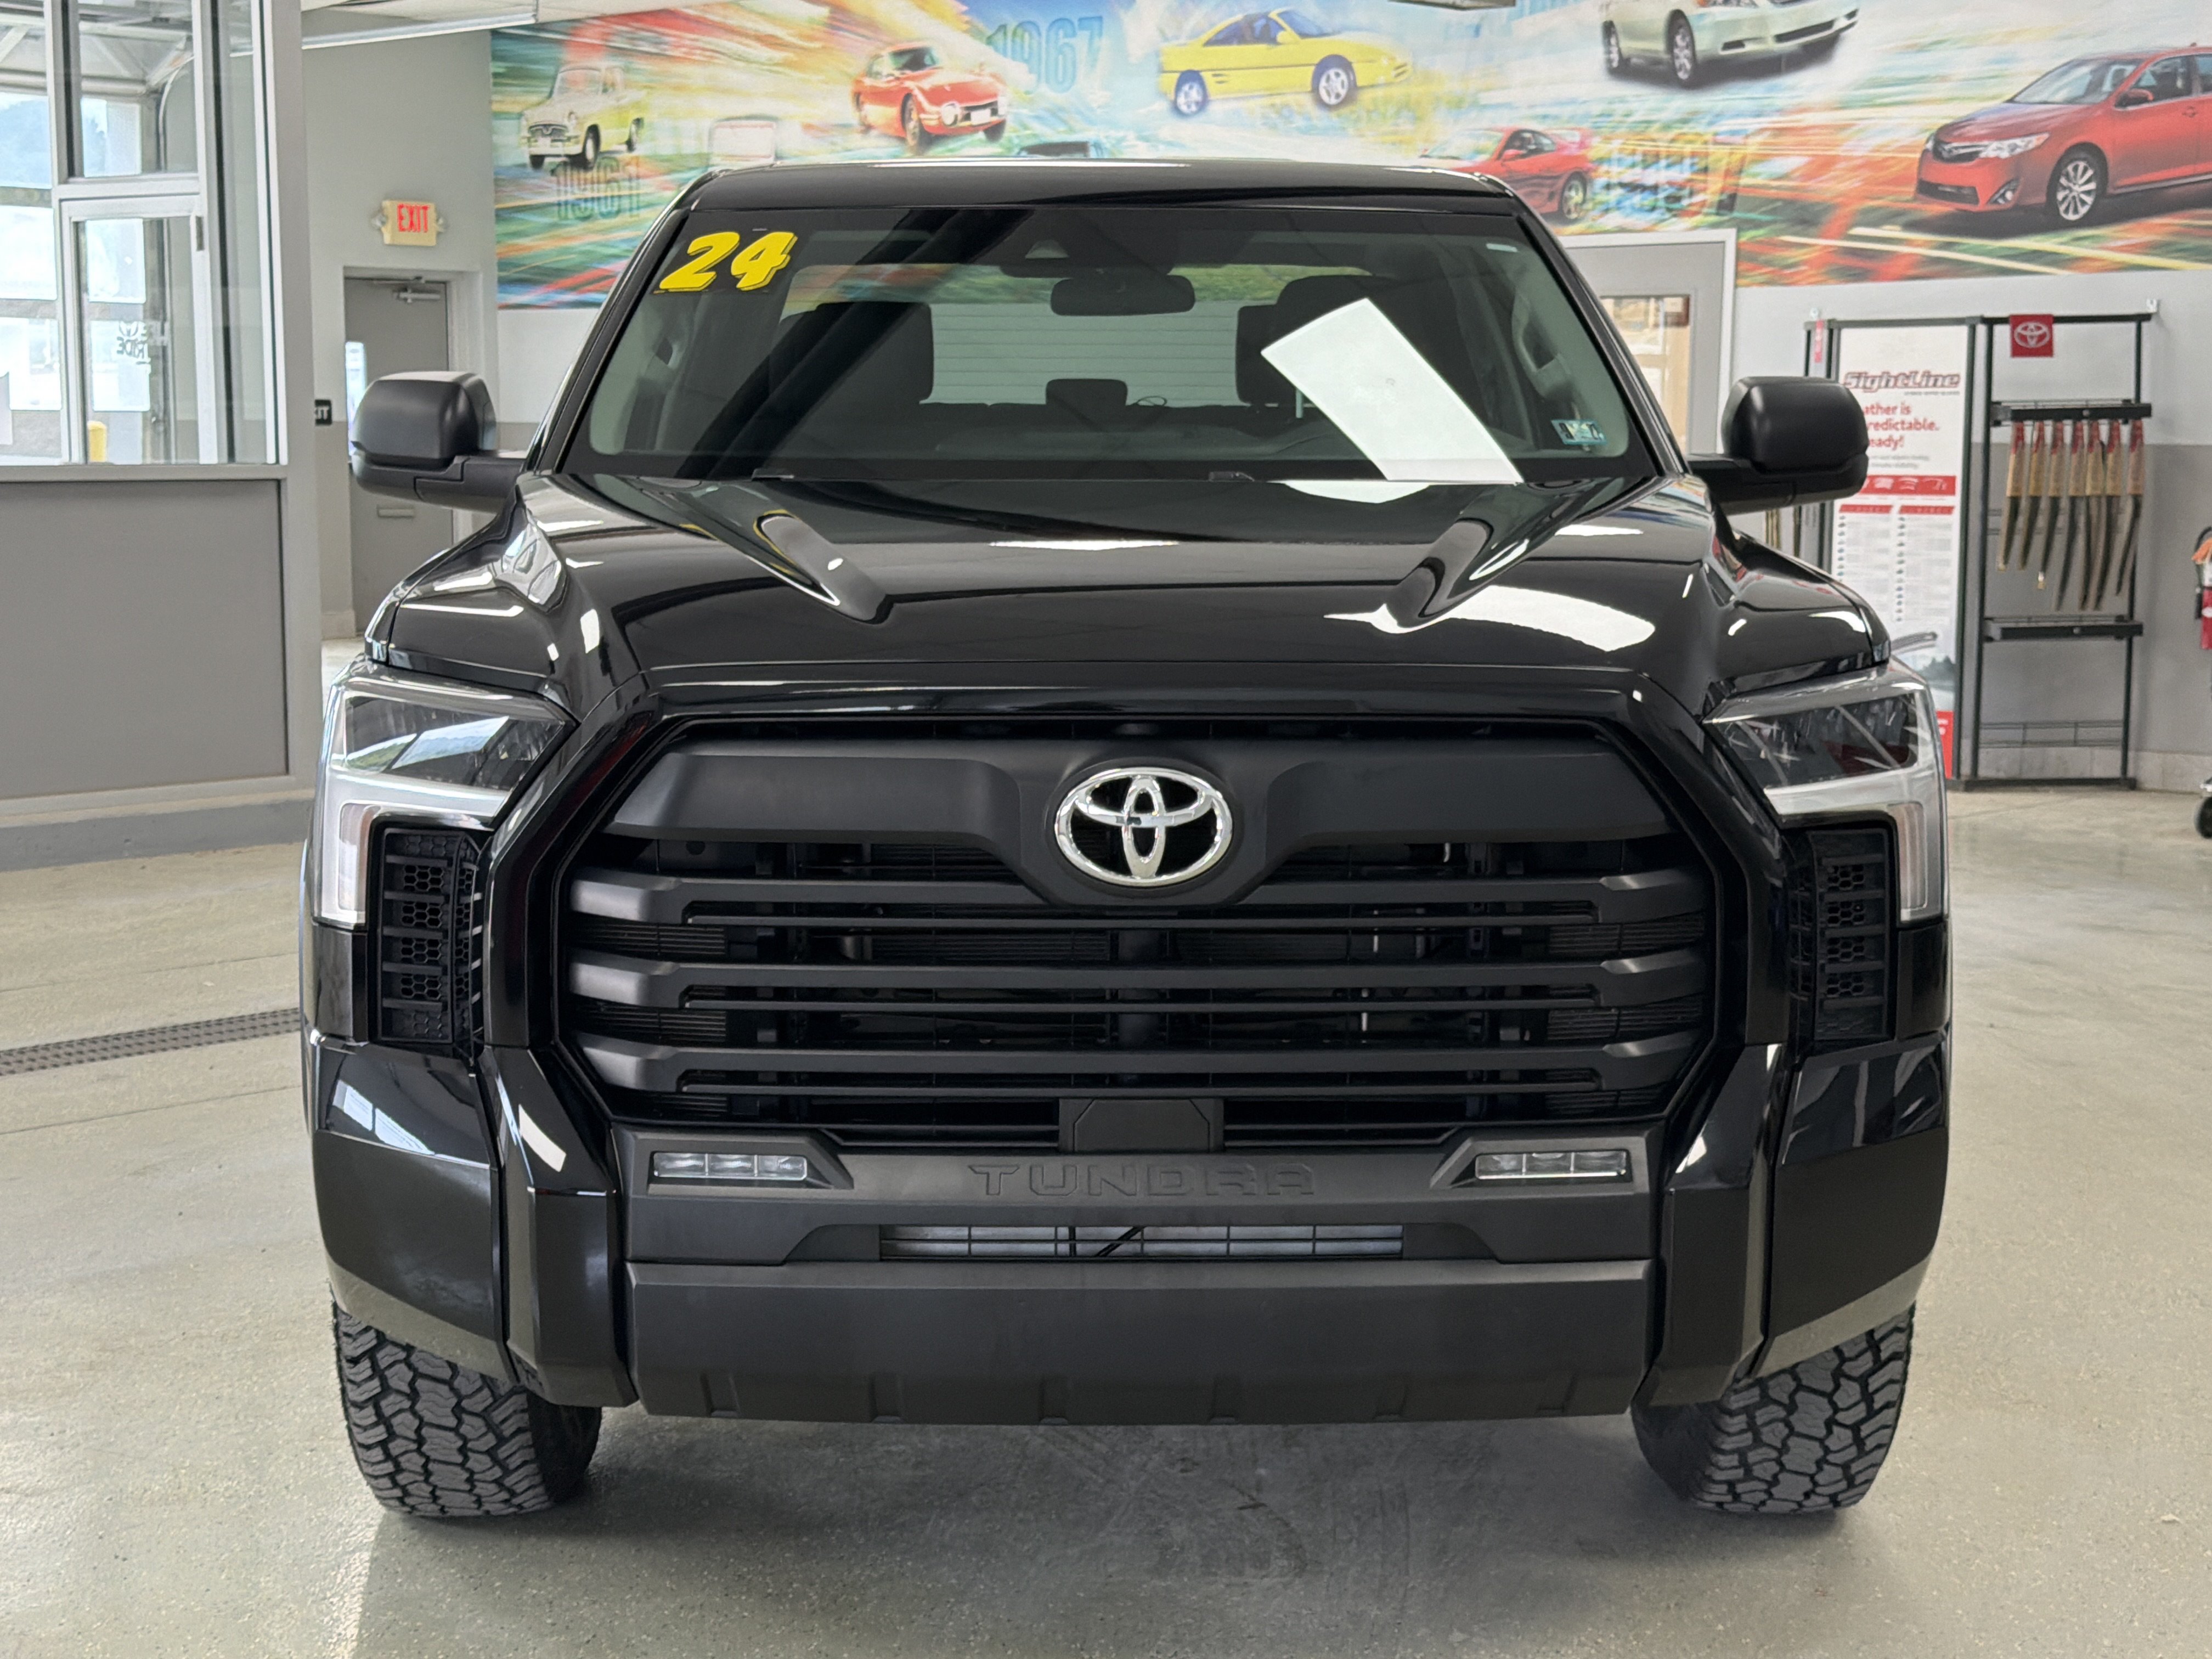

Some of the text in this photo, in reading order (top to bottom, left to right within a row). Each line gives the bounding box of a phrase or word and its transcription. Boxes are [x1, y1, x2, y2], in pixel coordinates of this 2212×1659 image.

[986, 16, 1103, 94] 1967
[397, 204, 430, 233] EXIT
[654, 232, 798, 293] 24
[1844, 370, 1961, 393] SightLine
[315, 406, 330, 420] IT
[1864, 400, 1912, 415] ather is
[1867, 417, 1940, 431] redictable.
[1869, 435, 1904, 451] eady!
[968, 1164, 1314, 1197] TUNDRA
